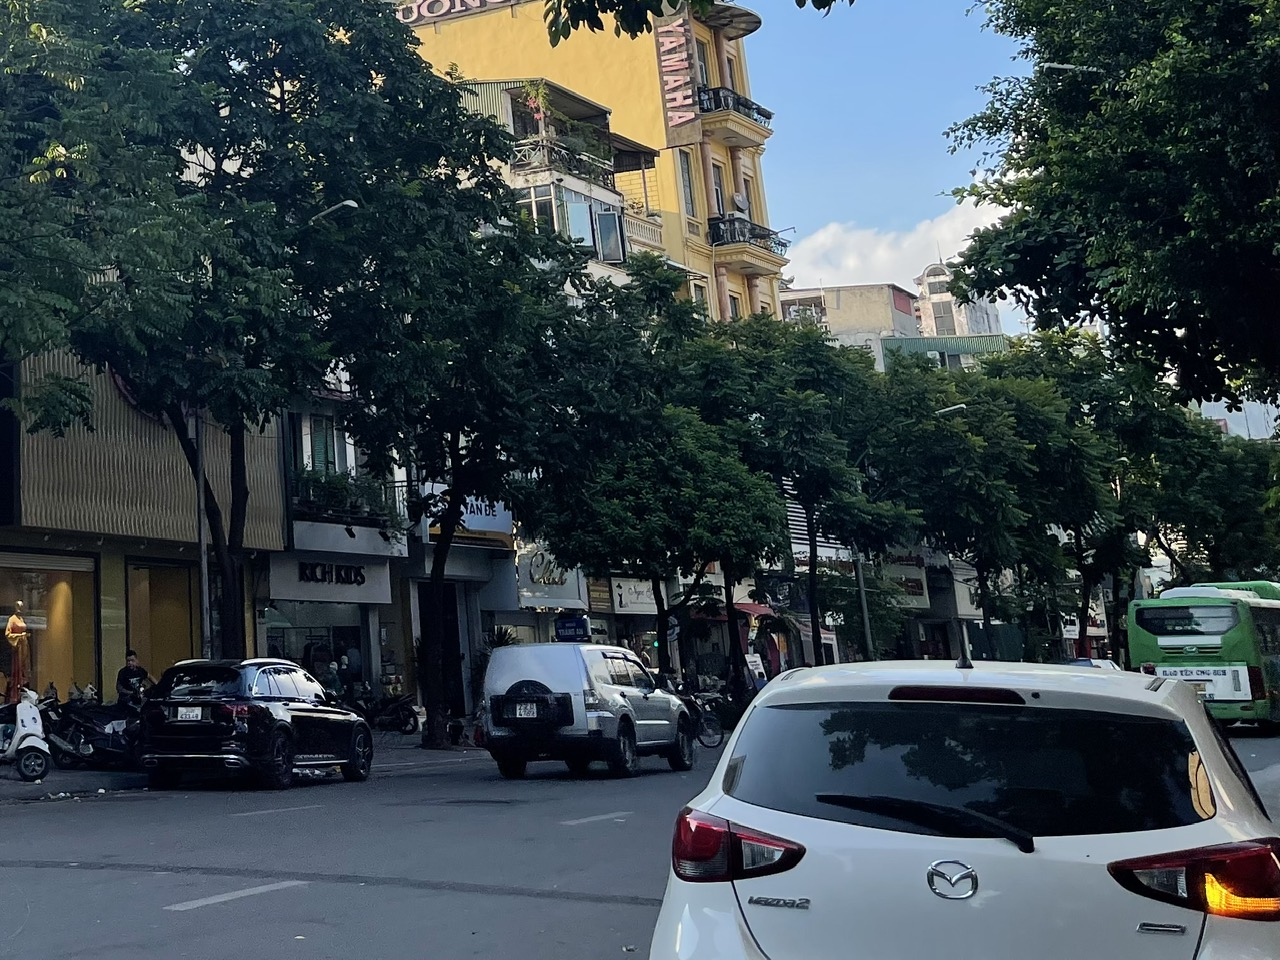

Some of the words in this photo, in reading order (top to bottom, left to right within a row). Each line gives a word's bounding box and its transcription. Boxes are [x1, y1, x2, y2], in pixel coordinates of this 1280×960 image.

[657, 17, 696, 128] YAMAHA
[298, 561, 334, 584] RICH
[334, 564, 366, 586] KIDS
